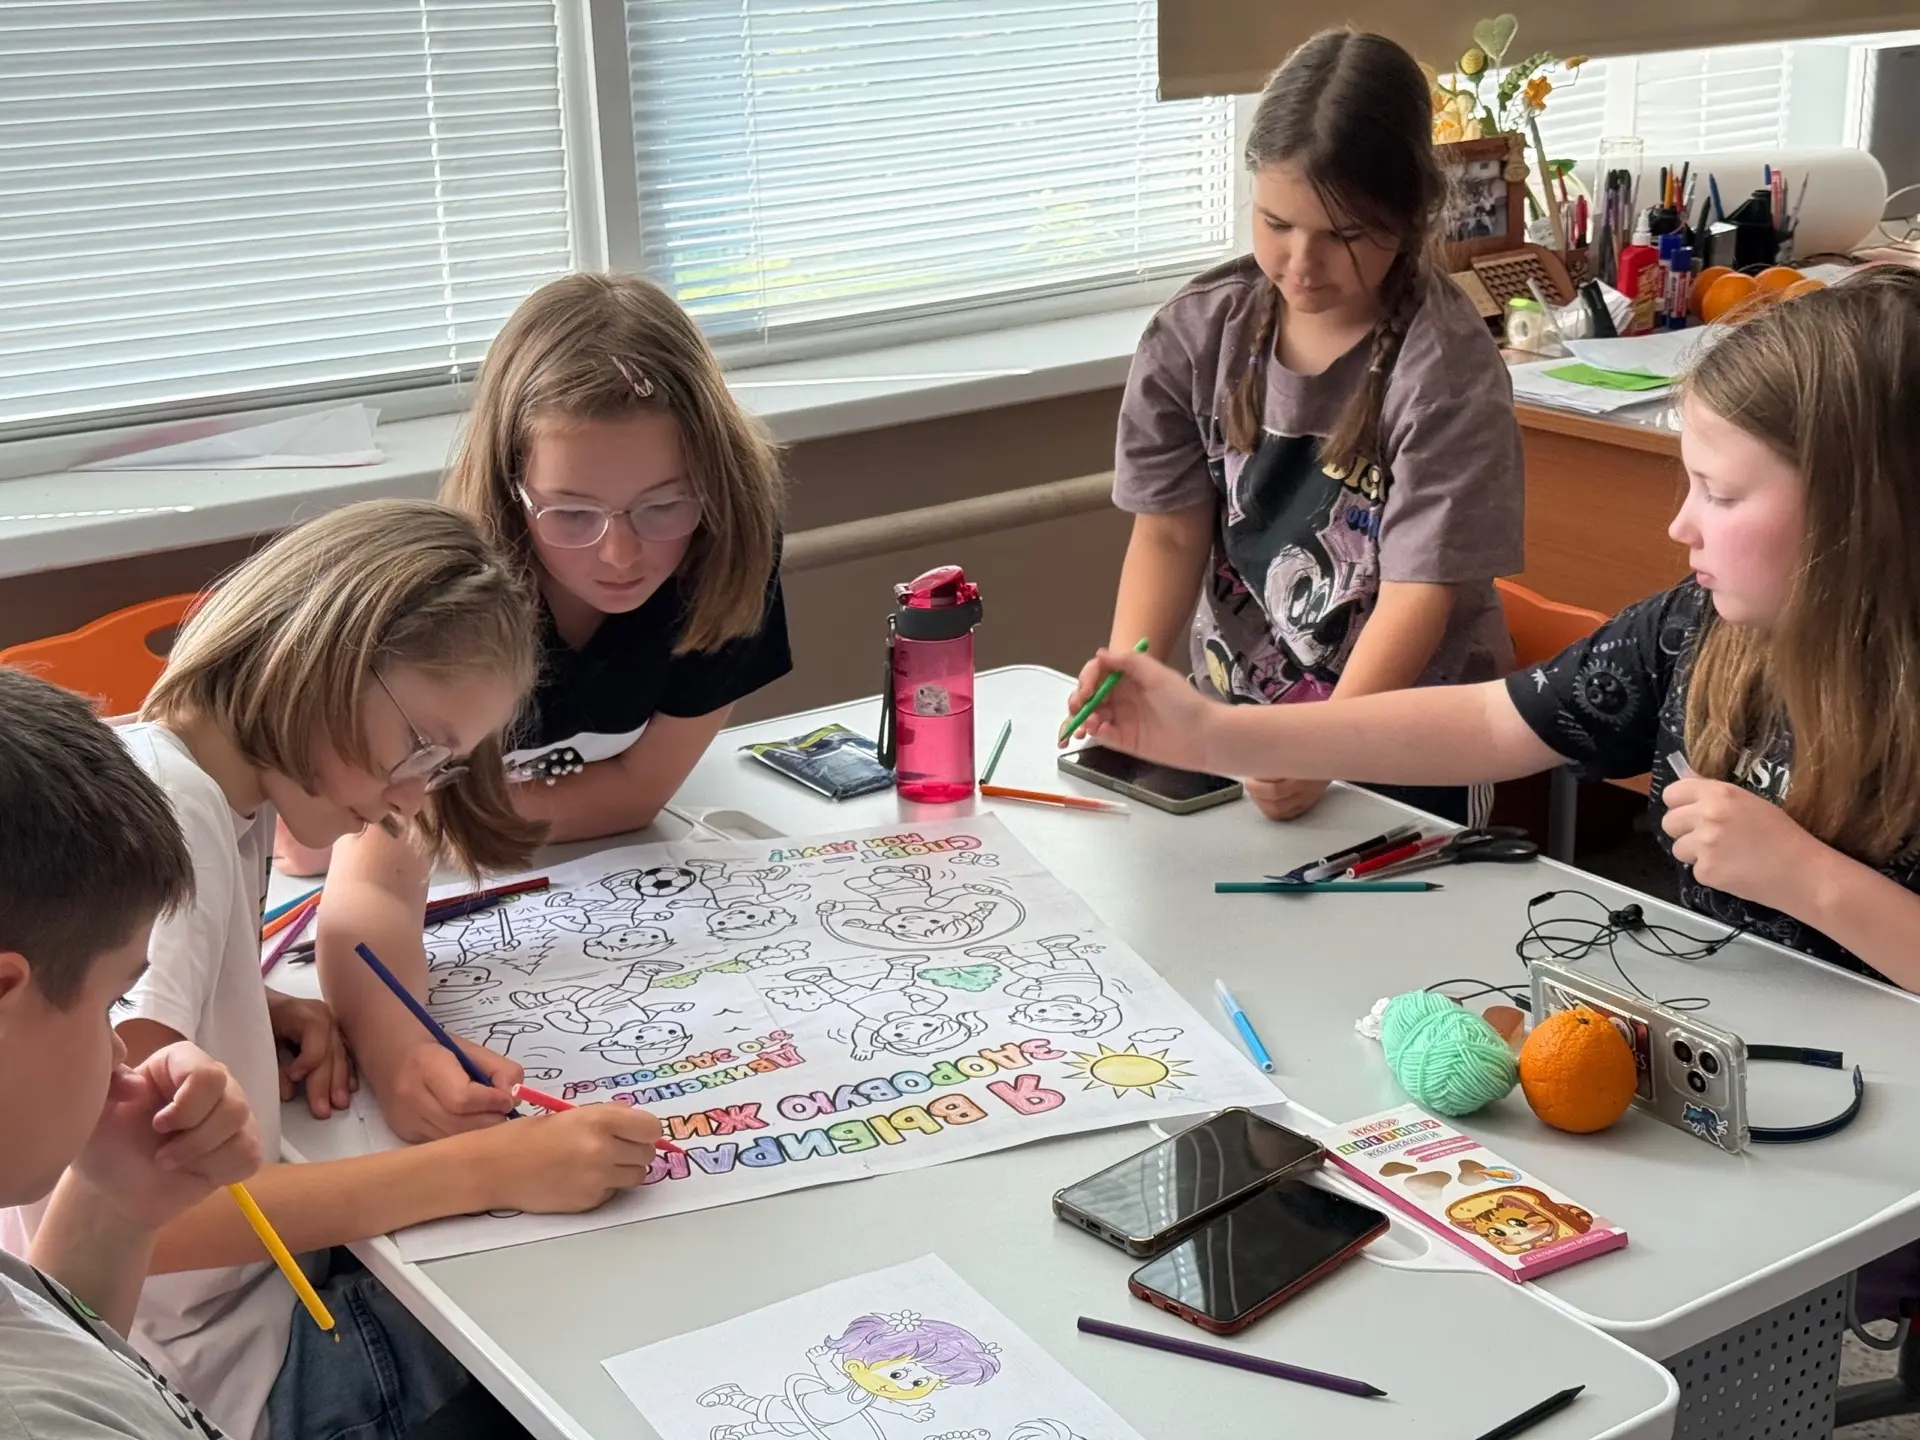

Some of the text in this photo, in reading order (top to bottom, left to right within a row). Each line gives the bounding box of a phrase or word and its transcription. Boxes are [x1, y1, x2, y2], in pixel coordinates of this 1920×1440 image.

[778, 1038, 1068, 1122] ЗДОРОВУЮ
[986, 1073, 1066, 1115] Я
[1336, 1119, 1442, 1156] ЦВЕТНЫХ
